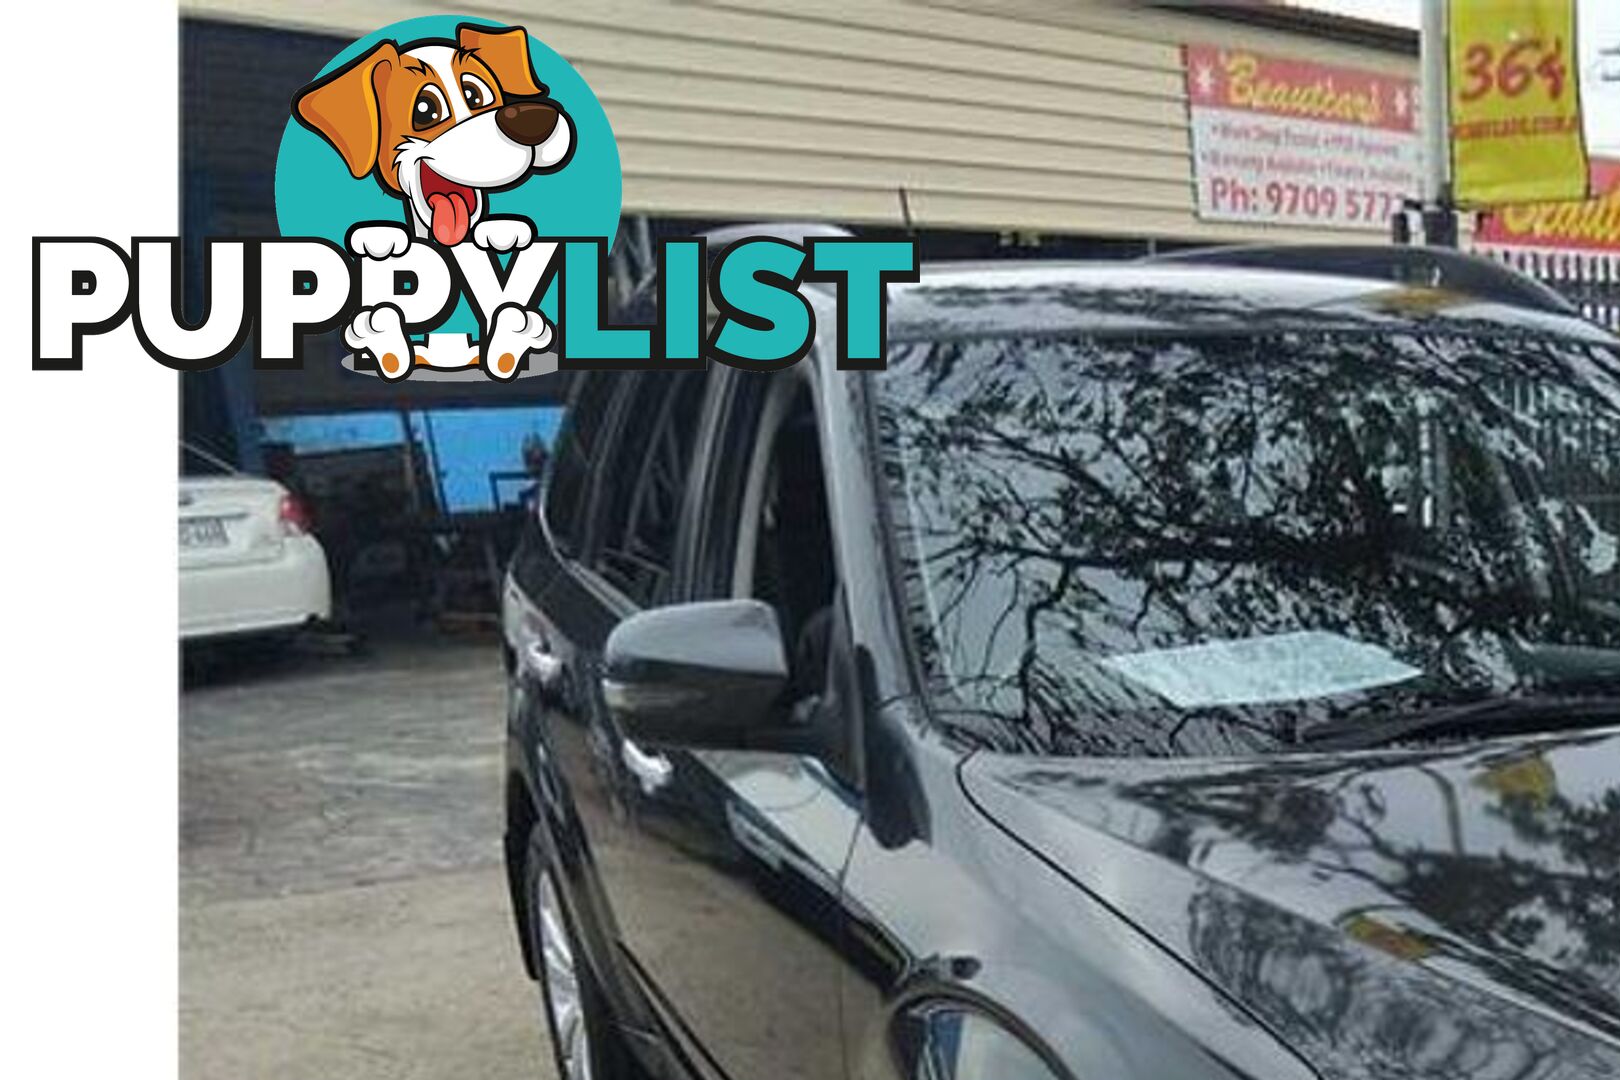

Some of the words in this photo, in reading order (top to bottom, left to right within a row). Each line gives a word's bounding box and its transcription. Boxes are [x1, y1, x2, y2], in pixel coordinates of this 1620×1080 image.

[1210, 177, 1258, 213] Ph:
[1266, 181, 1338, 219] 9709
[1344, 188, 1406, 222] 577
